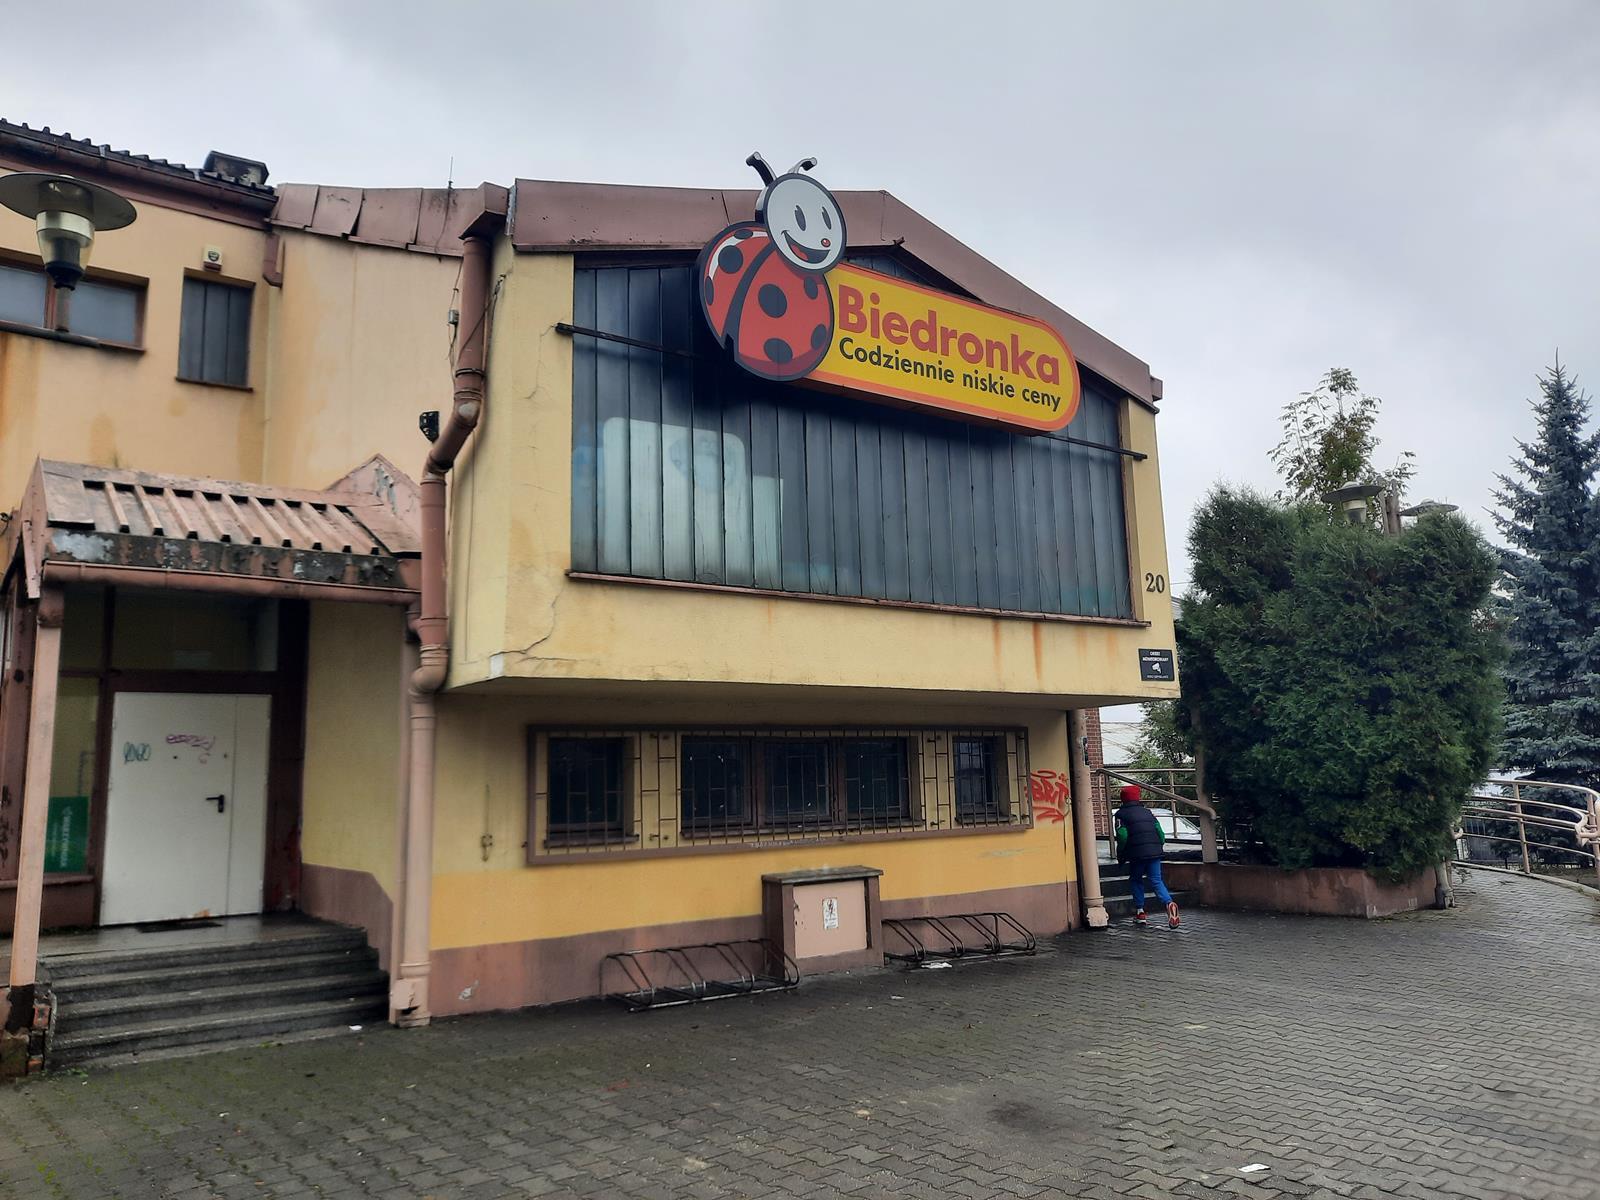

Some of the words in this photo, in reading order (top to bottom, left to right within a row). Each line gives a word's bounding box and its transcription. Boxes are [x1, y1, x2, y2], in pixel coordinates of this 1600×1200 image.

[838, 284, 1059, 386] Biedronka
[839, 337, 954, 384] Codziennie
[962, 369, 1015, 398] niskie
[1021, 388, 1061, 412] ceny
[1145, 572, 1165, 594] 20
